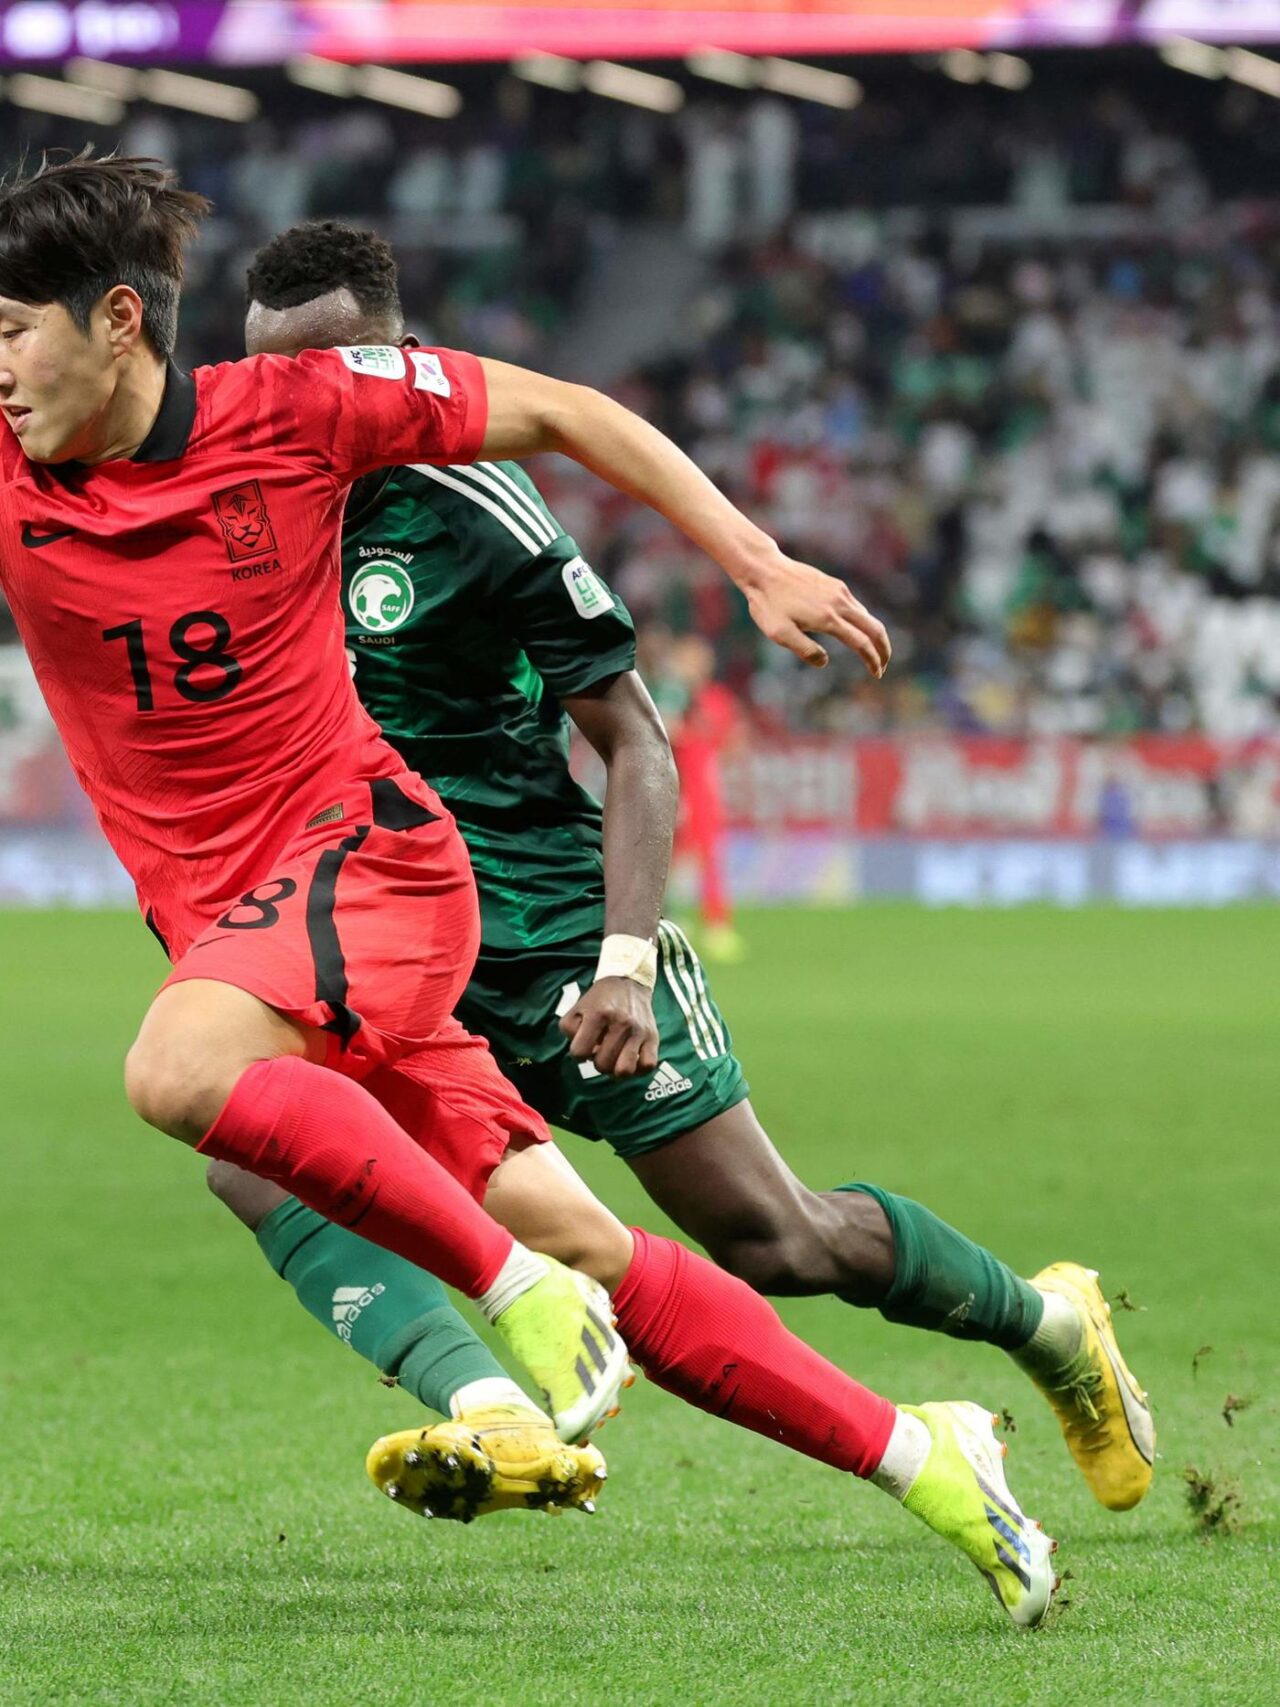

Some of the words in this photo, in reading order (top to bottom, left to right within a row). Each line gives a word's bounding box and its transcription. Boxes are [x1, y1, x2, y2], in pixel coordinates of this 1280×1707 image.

[358, 546, 415, 565] السعودية
[231, 559, 282, 581] KOREA
[381, 604, 401, 613] SAFF
[358, 635, 395, 645] SAUDI
[102, 610, 244, 711] 18
[644, 1077, 693, 1101] adidas
